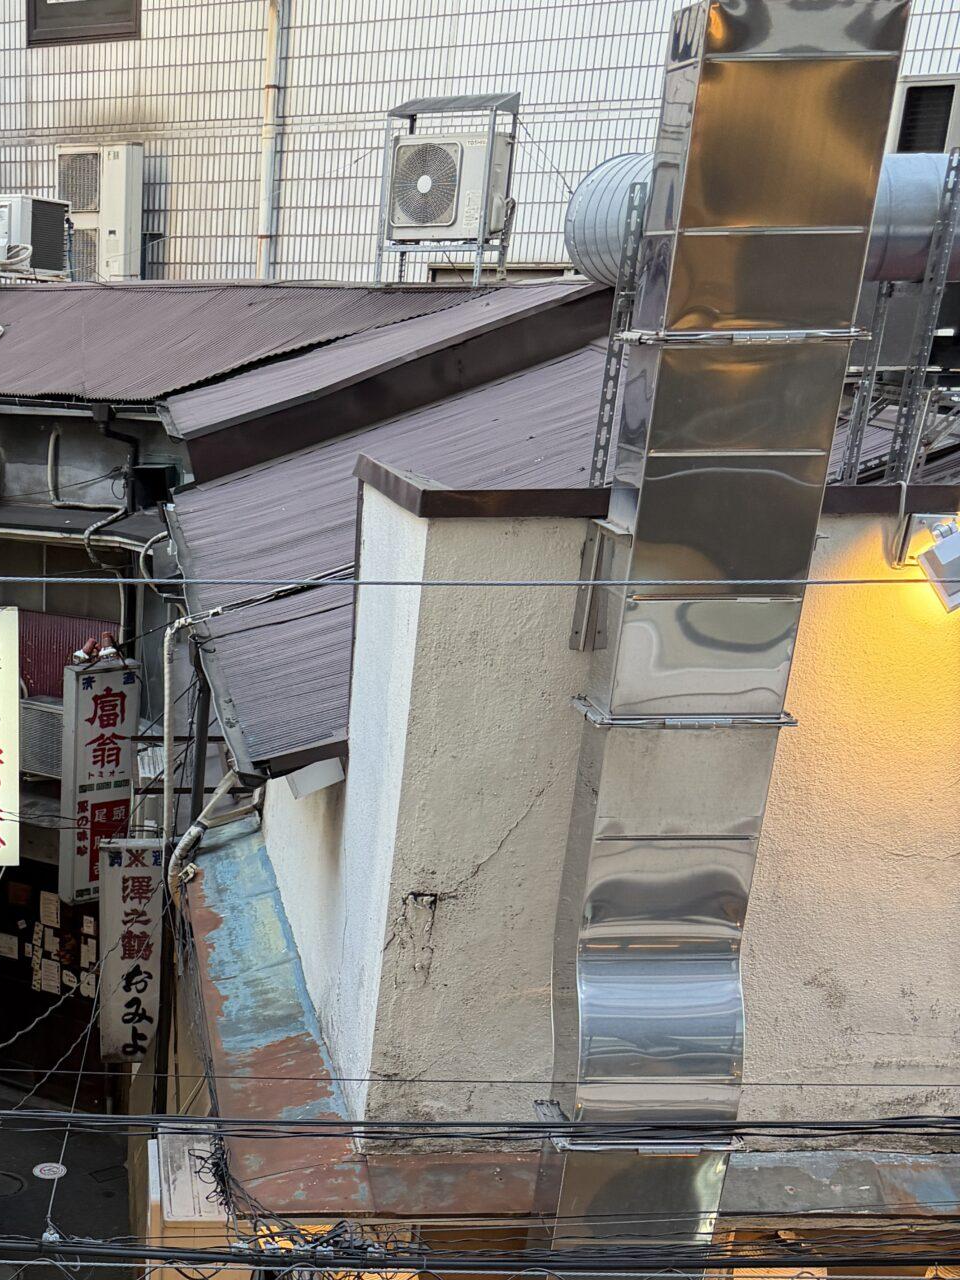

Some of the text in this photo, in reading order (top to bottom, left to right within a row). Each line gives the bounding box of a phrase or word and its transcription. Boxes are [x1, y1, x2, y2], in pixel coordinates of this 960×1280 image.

[85, 686, 130, 770] 富翁
[121, 875, 156, 961] 澤之鶴
[121, 963, 154, 1056] おみよ
